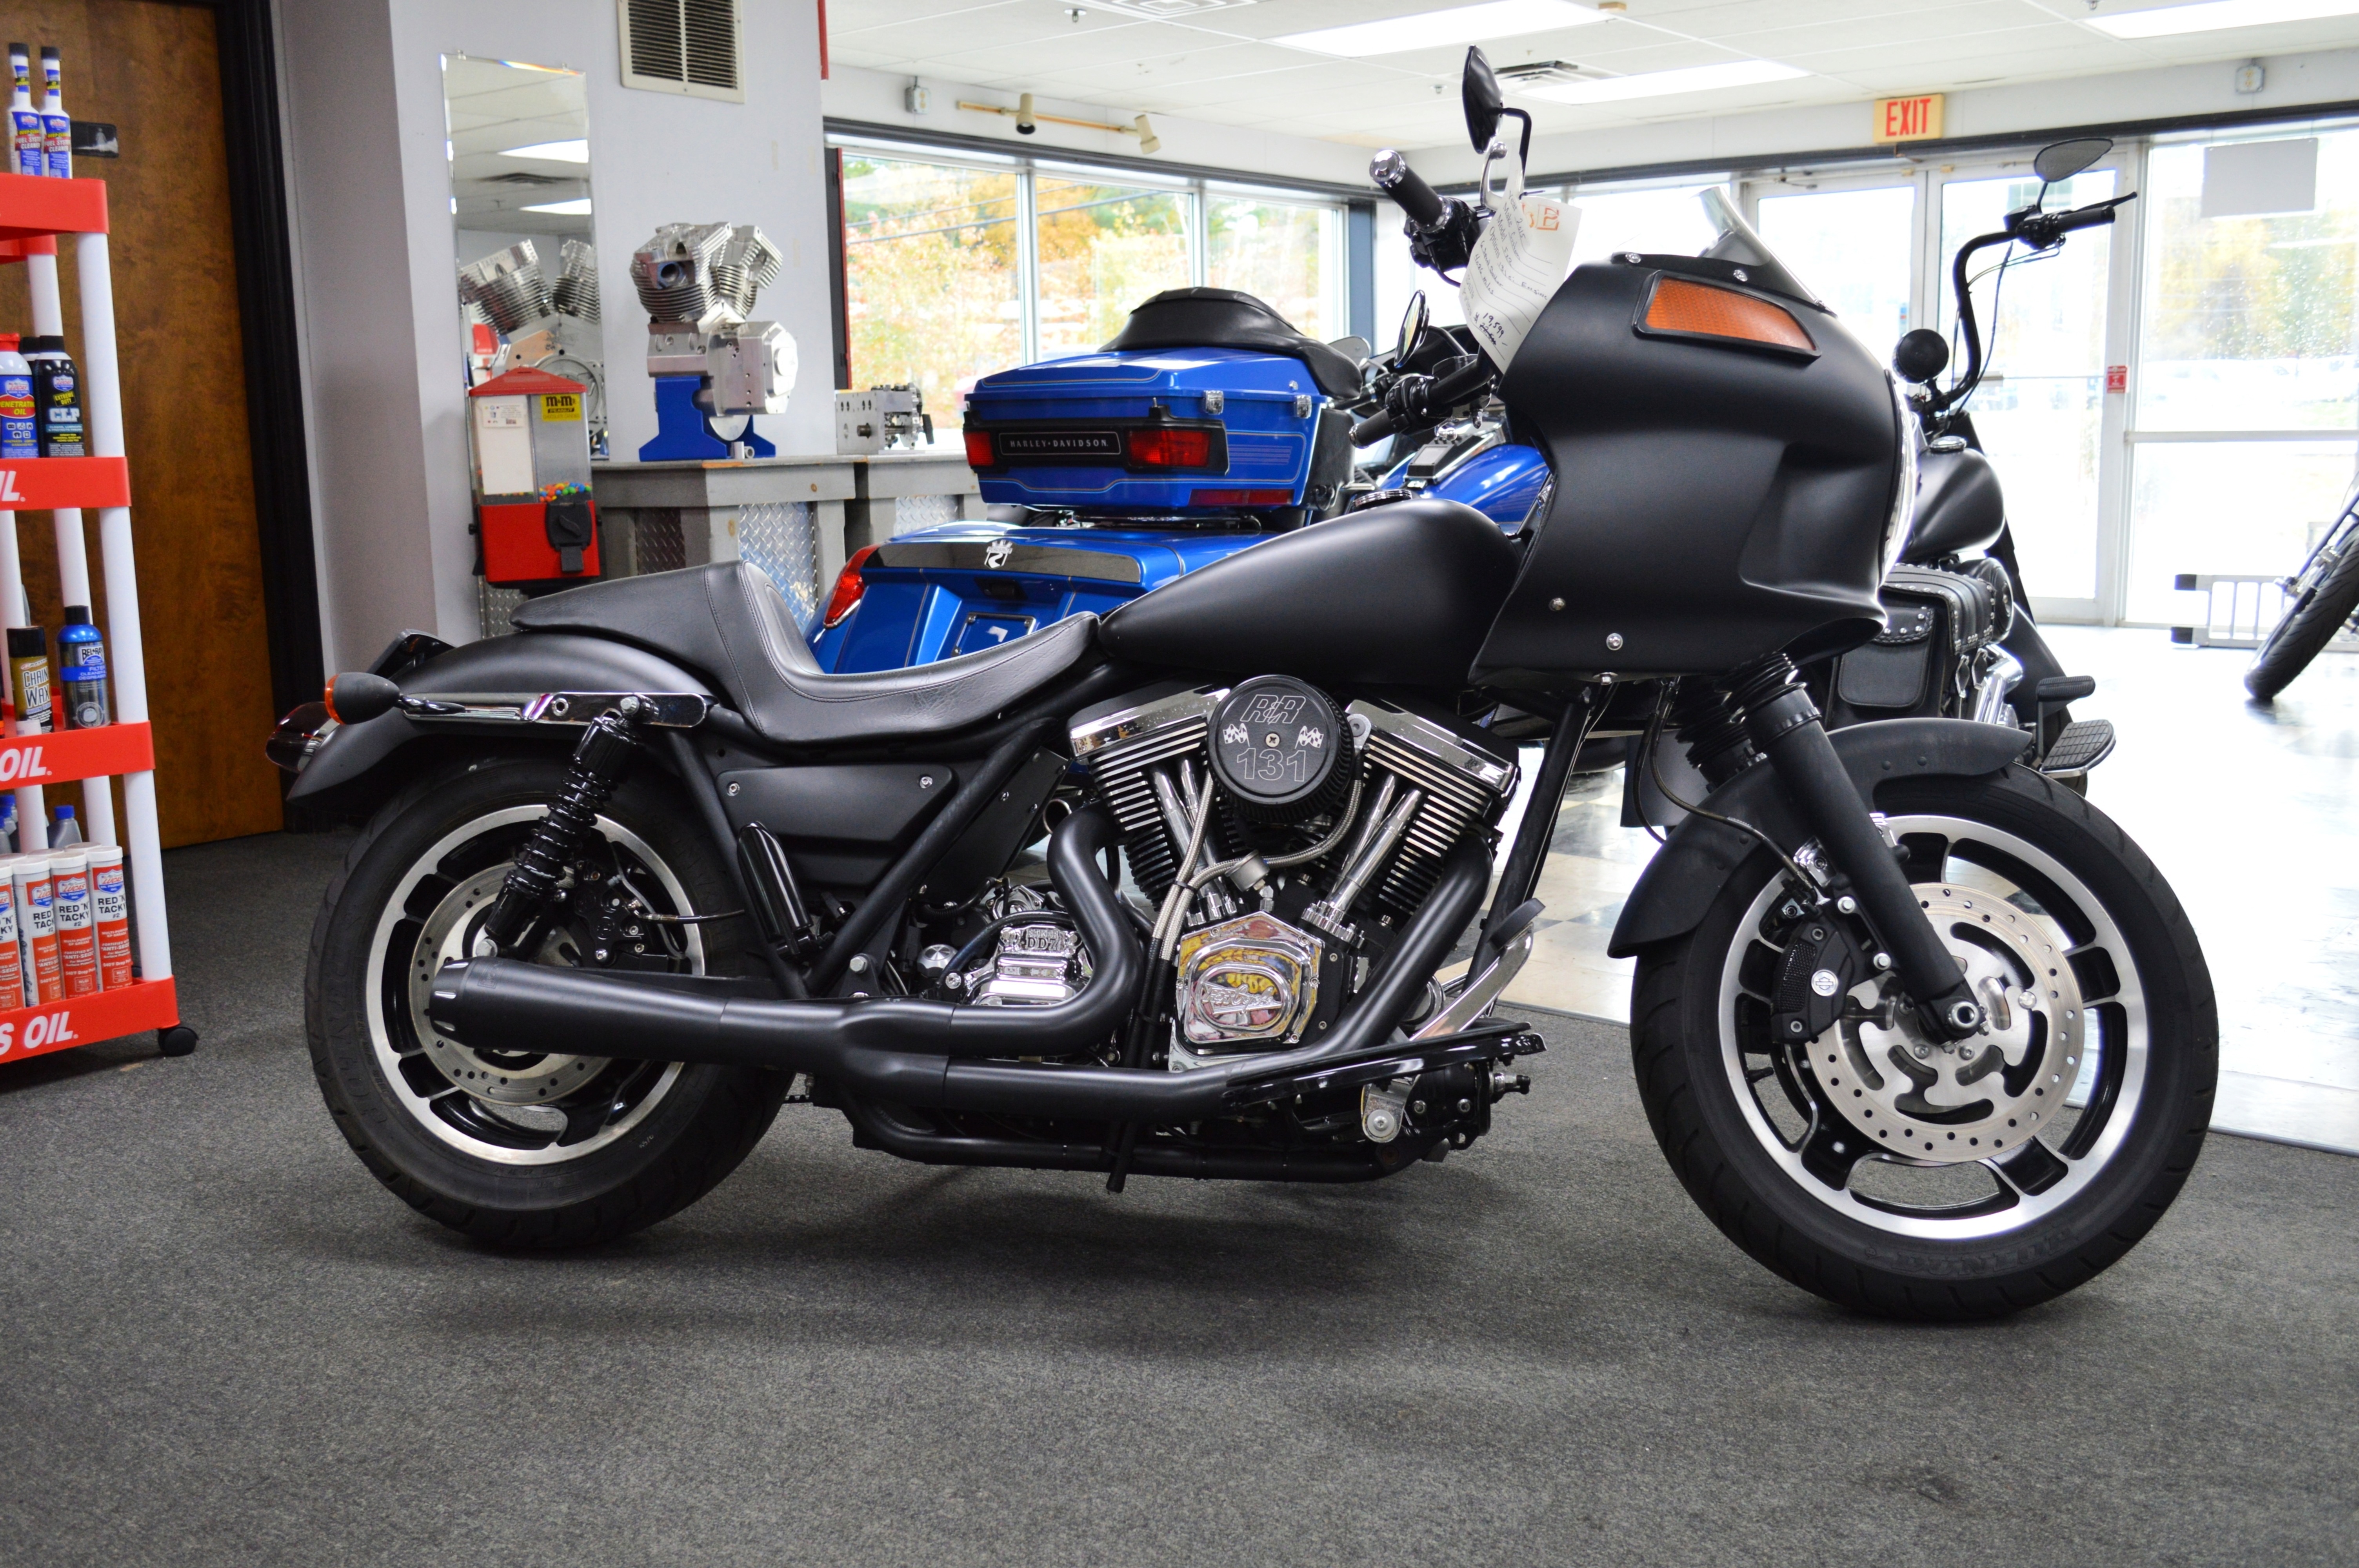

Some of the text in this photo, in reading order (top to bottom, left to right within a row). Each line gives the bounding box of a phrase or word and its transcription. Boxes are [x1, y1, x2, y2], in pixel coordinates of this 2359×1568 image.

[1886, 99, 1931, 136] EXIT
[1508, 190, 1517, 211] Year
[1503, 202, 1512, 227] Make
[1497, 214, 1508, 242] Model
[1490, 226, 1501, 259] Options
[1483, 312, 1505, 338] 19,599
[55, 391, 74, 401] EXTREME
[50, 407, 80, 422] CLP
[24, 667, 48, 687] CHAIN
[25, 686, 50, 707] WAX
[1240, 694, 1306, 724] R&R
[0, 746, 47, 781] OIL
[1237, 748, 1306, 782] 131
[63, 884, 85, 892] LUCAS
[59, 905, 80, 913] RED
[98, 897, 118, 905] RED
[34, 910, 51, 921] RED
[60, 911, 89, 922] TACKY
[24, 1011, 74, 1049] OIL
